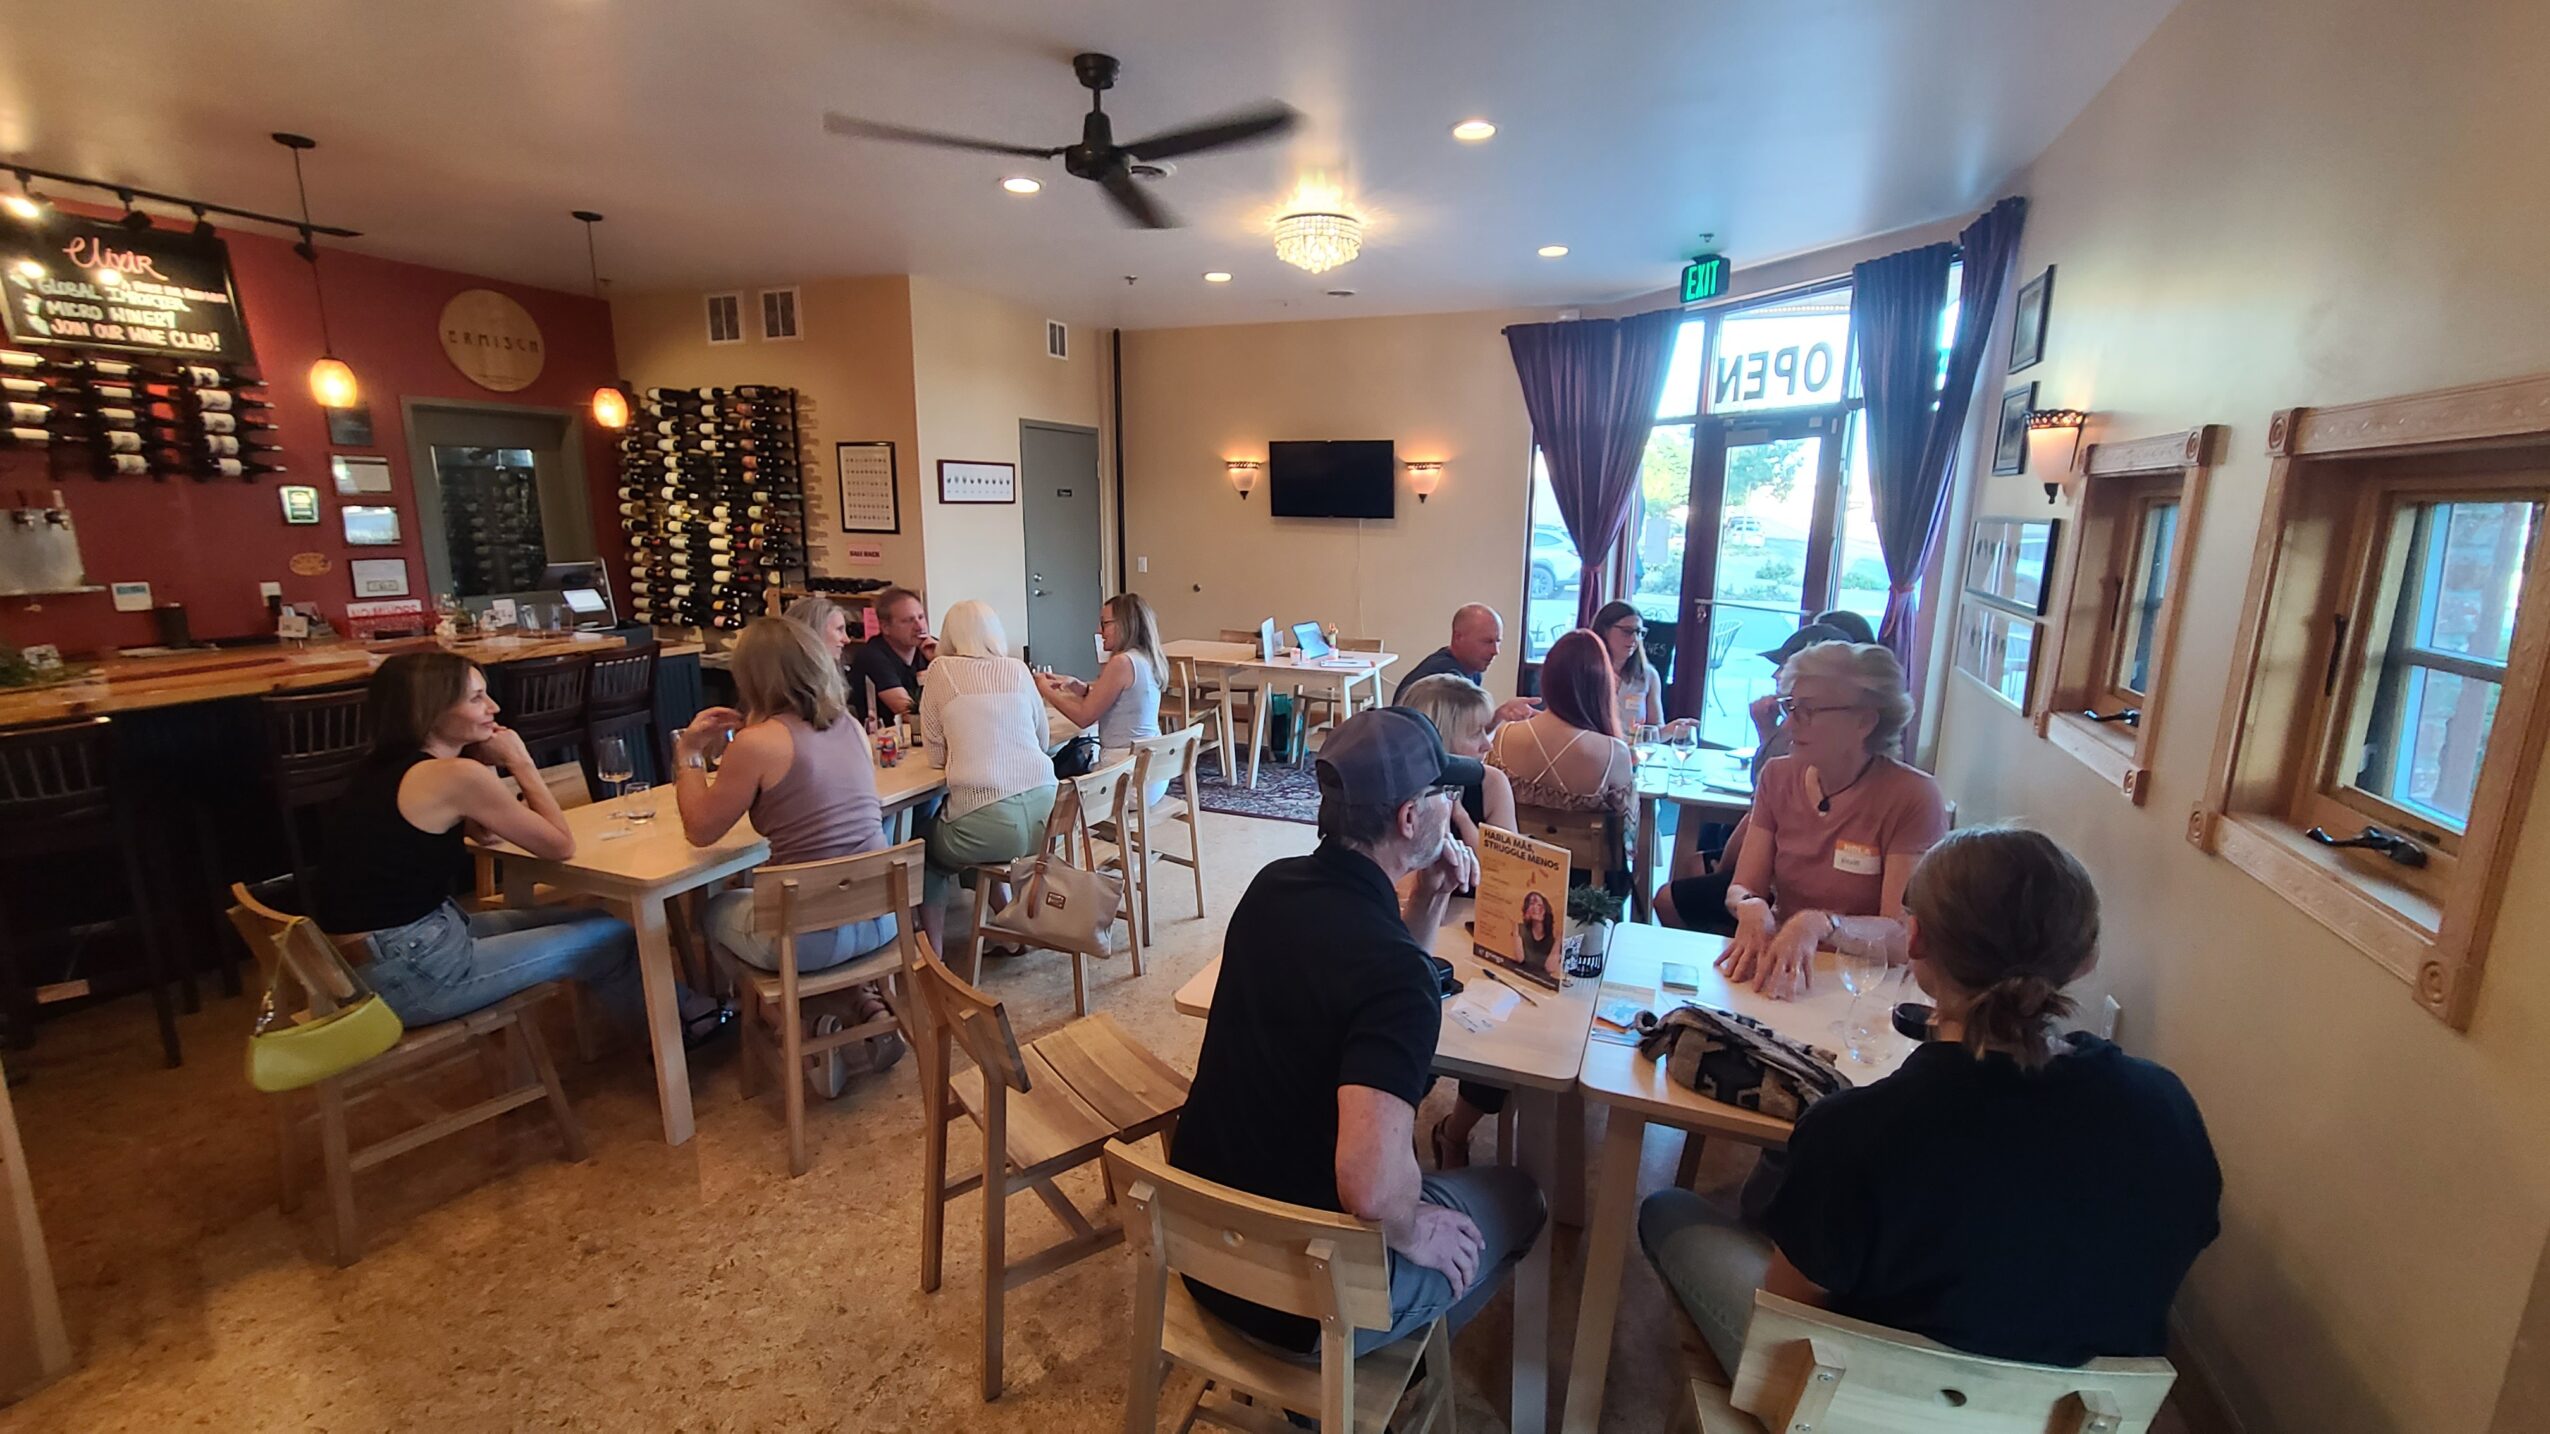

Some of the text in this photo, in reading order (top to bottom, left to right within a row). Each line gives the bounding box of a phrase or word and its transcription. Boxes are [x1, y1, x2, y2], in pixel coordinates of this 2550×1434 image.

[37, 278, 103, 300] GLOBAL
[1686, 260, 1720, 301] EXIT
[46, 300, 176, 328] MICRO WINERY
[51, 318, 222, 351] JOIN OUR WINE CLUB!
[1484, 829, 1512, 845] HABLA
[1484, 839, 1560, 871] STRUGGLE MENOS
